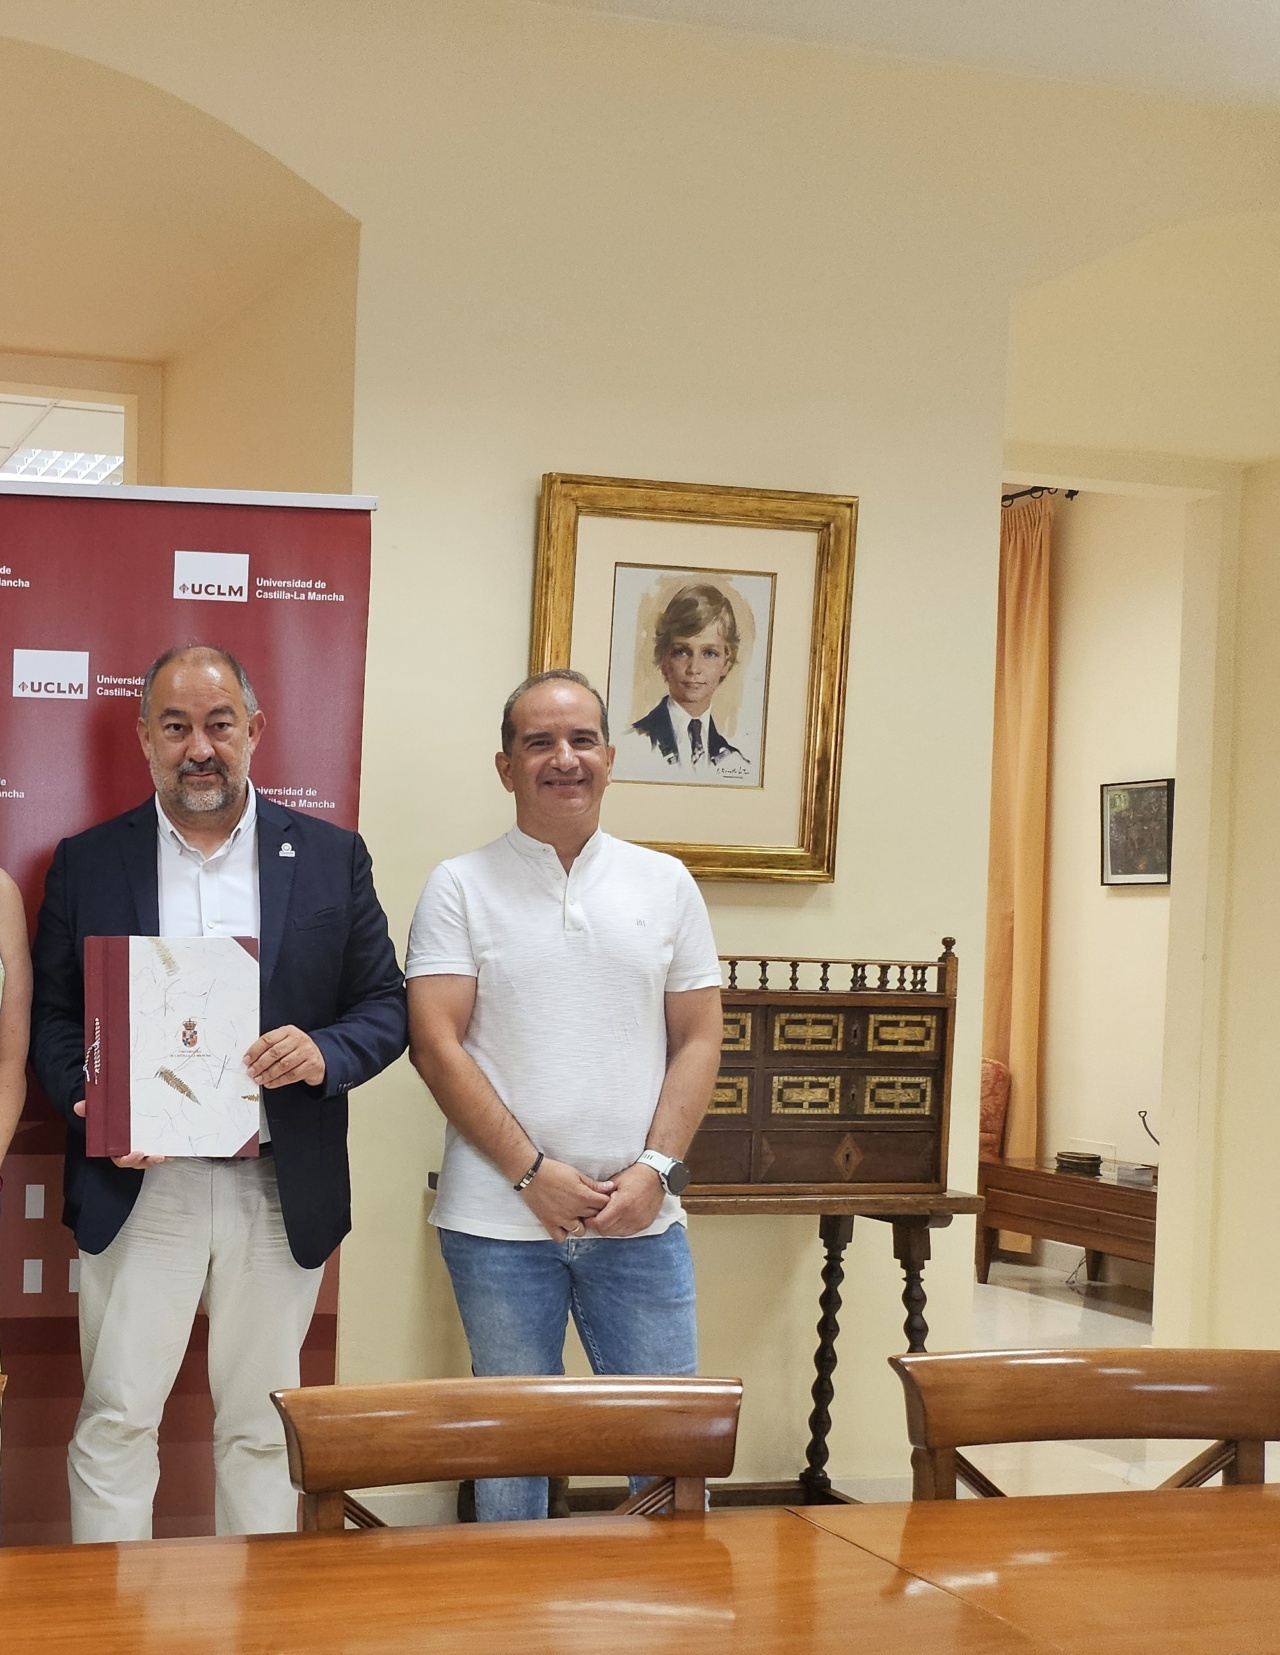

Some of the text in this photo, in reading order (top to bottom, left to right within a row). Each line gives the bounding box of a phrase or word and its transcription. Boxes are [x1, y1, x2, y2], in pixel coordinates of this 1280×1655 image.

[0, 565, 11, 575] de
[256, 578, 326, 589] Universidad de
[191, 583, 243, 597] UCLM
[256, 590, 345, 602] Castilla-La Mancha
[96, 675, 145, 686] Universida
[30, 681, 84, 695] UCLM
[255, 786, 317, 797] niversidad de
[298, 799, 336, 809] Mancha
